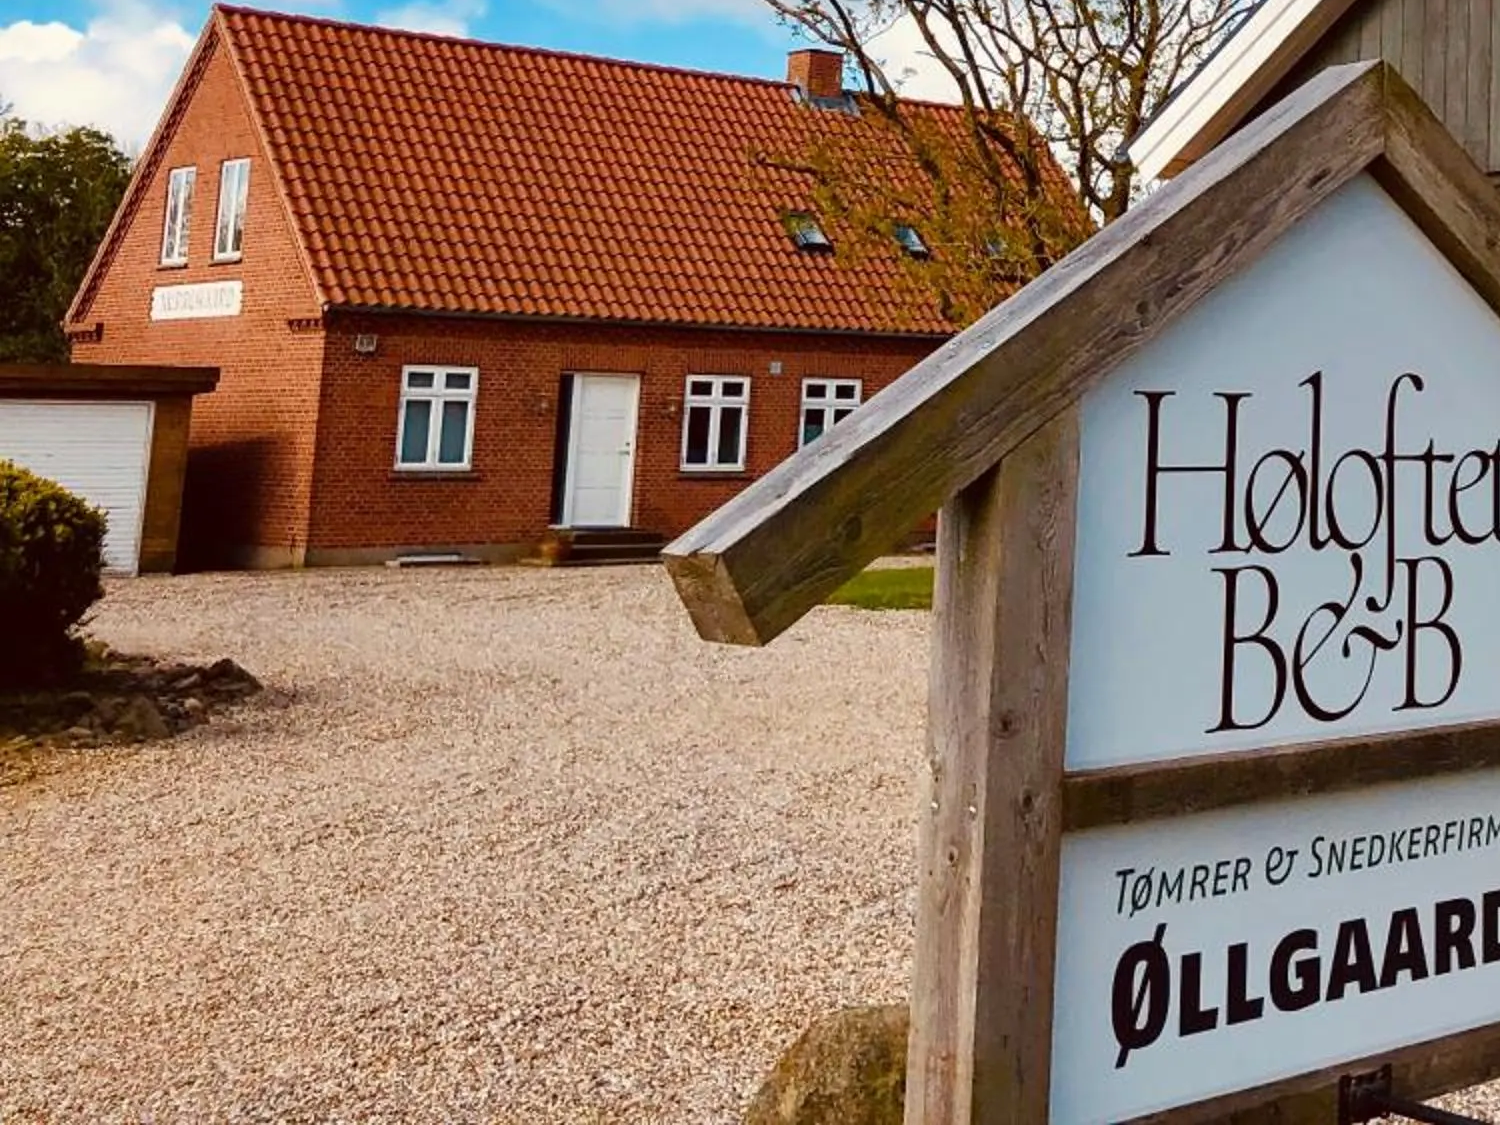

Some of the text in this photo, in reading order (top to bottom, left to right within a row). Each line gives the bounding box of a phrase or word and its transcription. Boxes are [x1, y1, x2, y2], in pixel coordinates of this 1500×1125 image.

[1204, 552, 1463, 734] B&B
[1115, 857, 1252, 919] TØMRER
[1264, 845, 1299, 886] &
